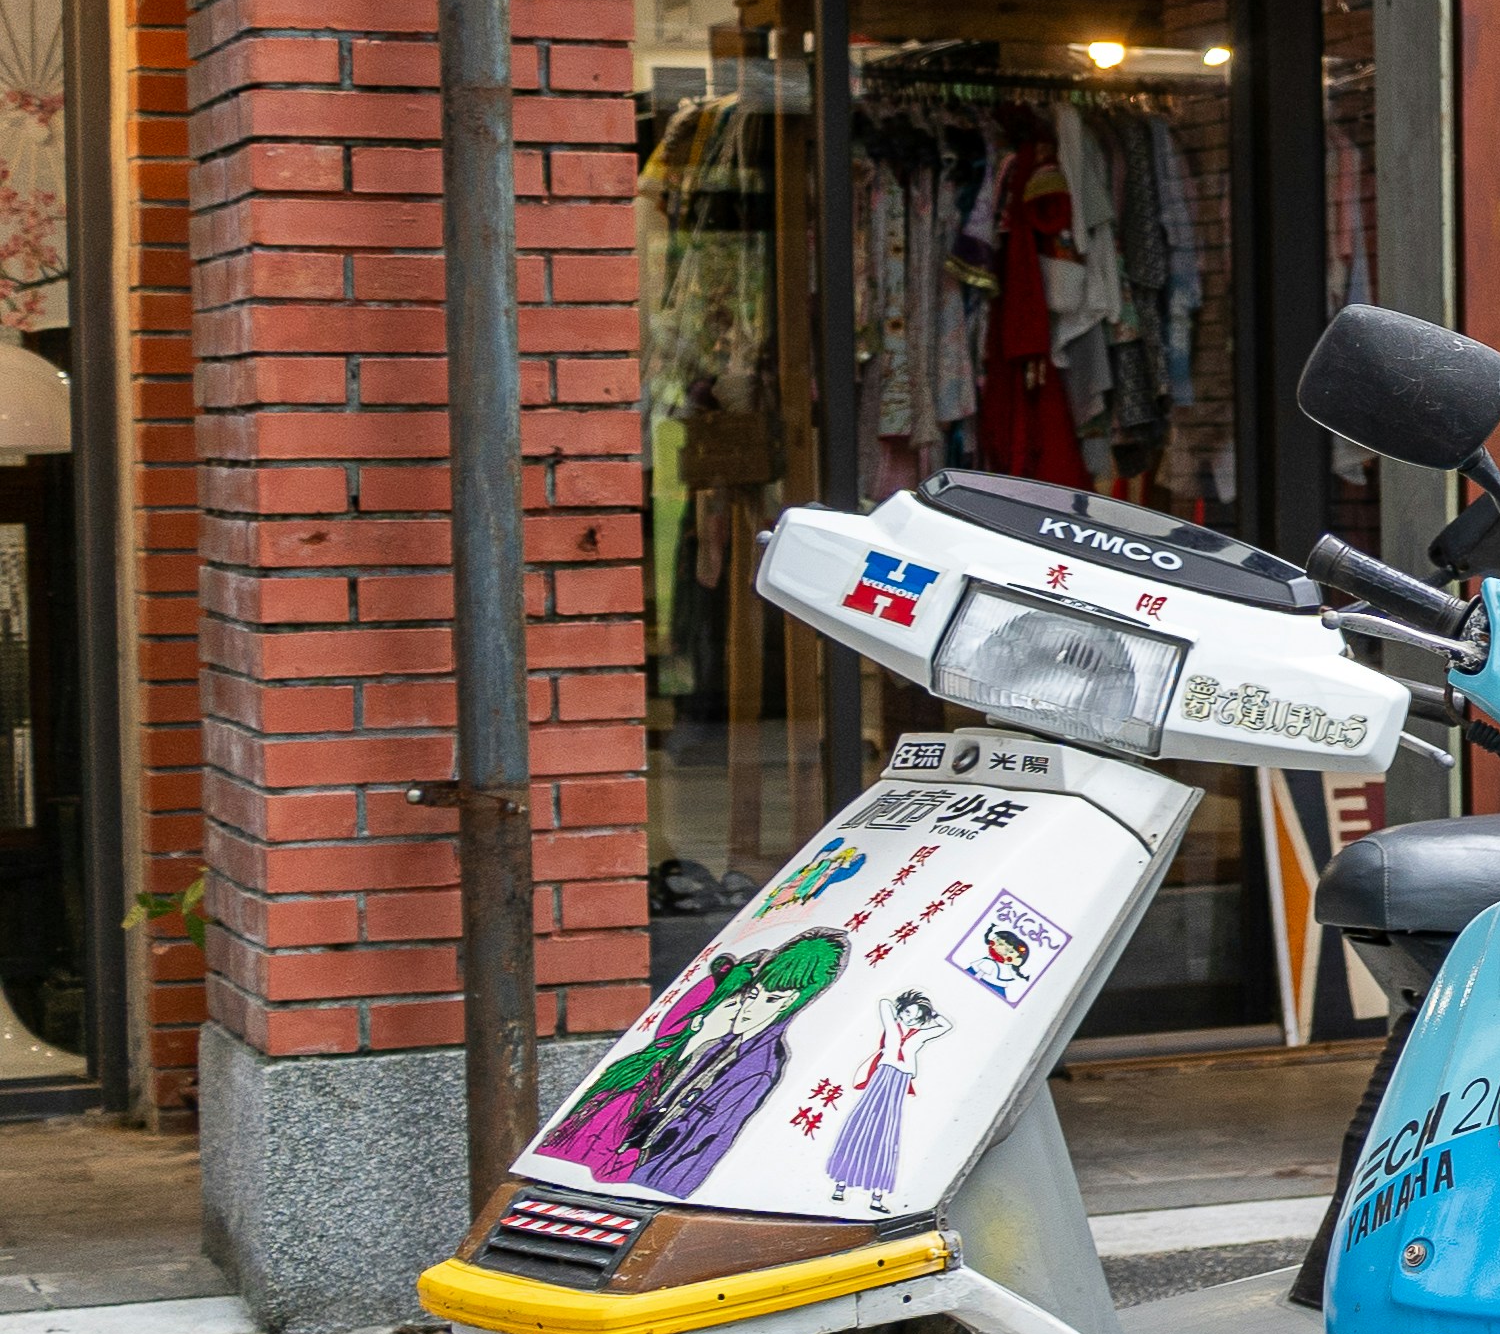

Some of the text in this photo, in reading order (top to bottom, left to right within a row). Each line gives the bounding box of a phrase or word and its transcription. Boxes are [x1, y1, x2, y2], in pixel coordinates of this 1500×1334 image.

[1039, 517, 1183, 571] KYMCO
[860, 576, 920, 603] HONDA
[892, 743, 946, 770] 名流
[989, 752, 1049, 774] 光陽
[929, 824, 979, 841] YOUNG
[1345, 1149, 1454, 1253] YAMAHA
